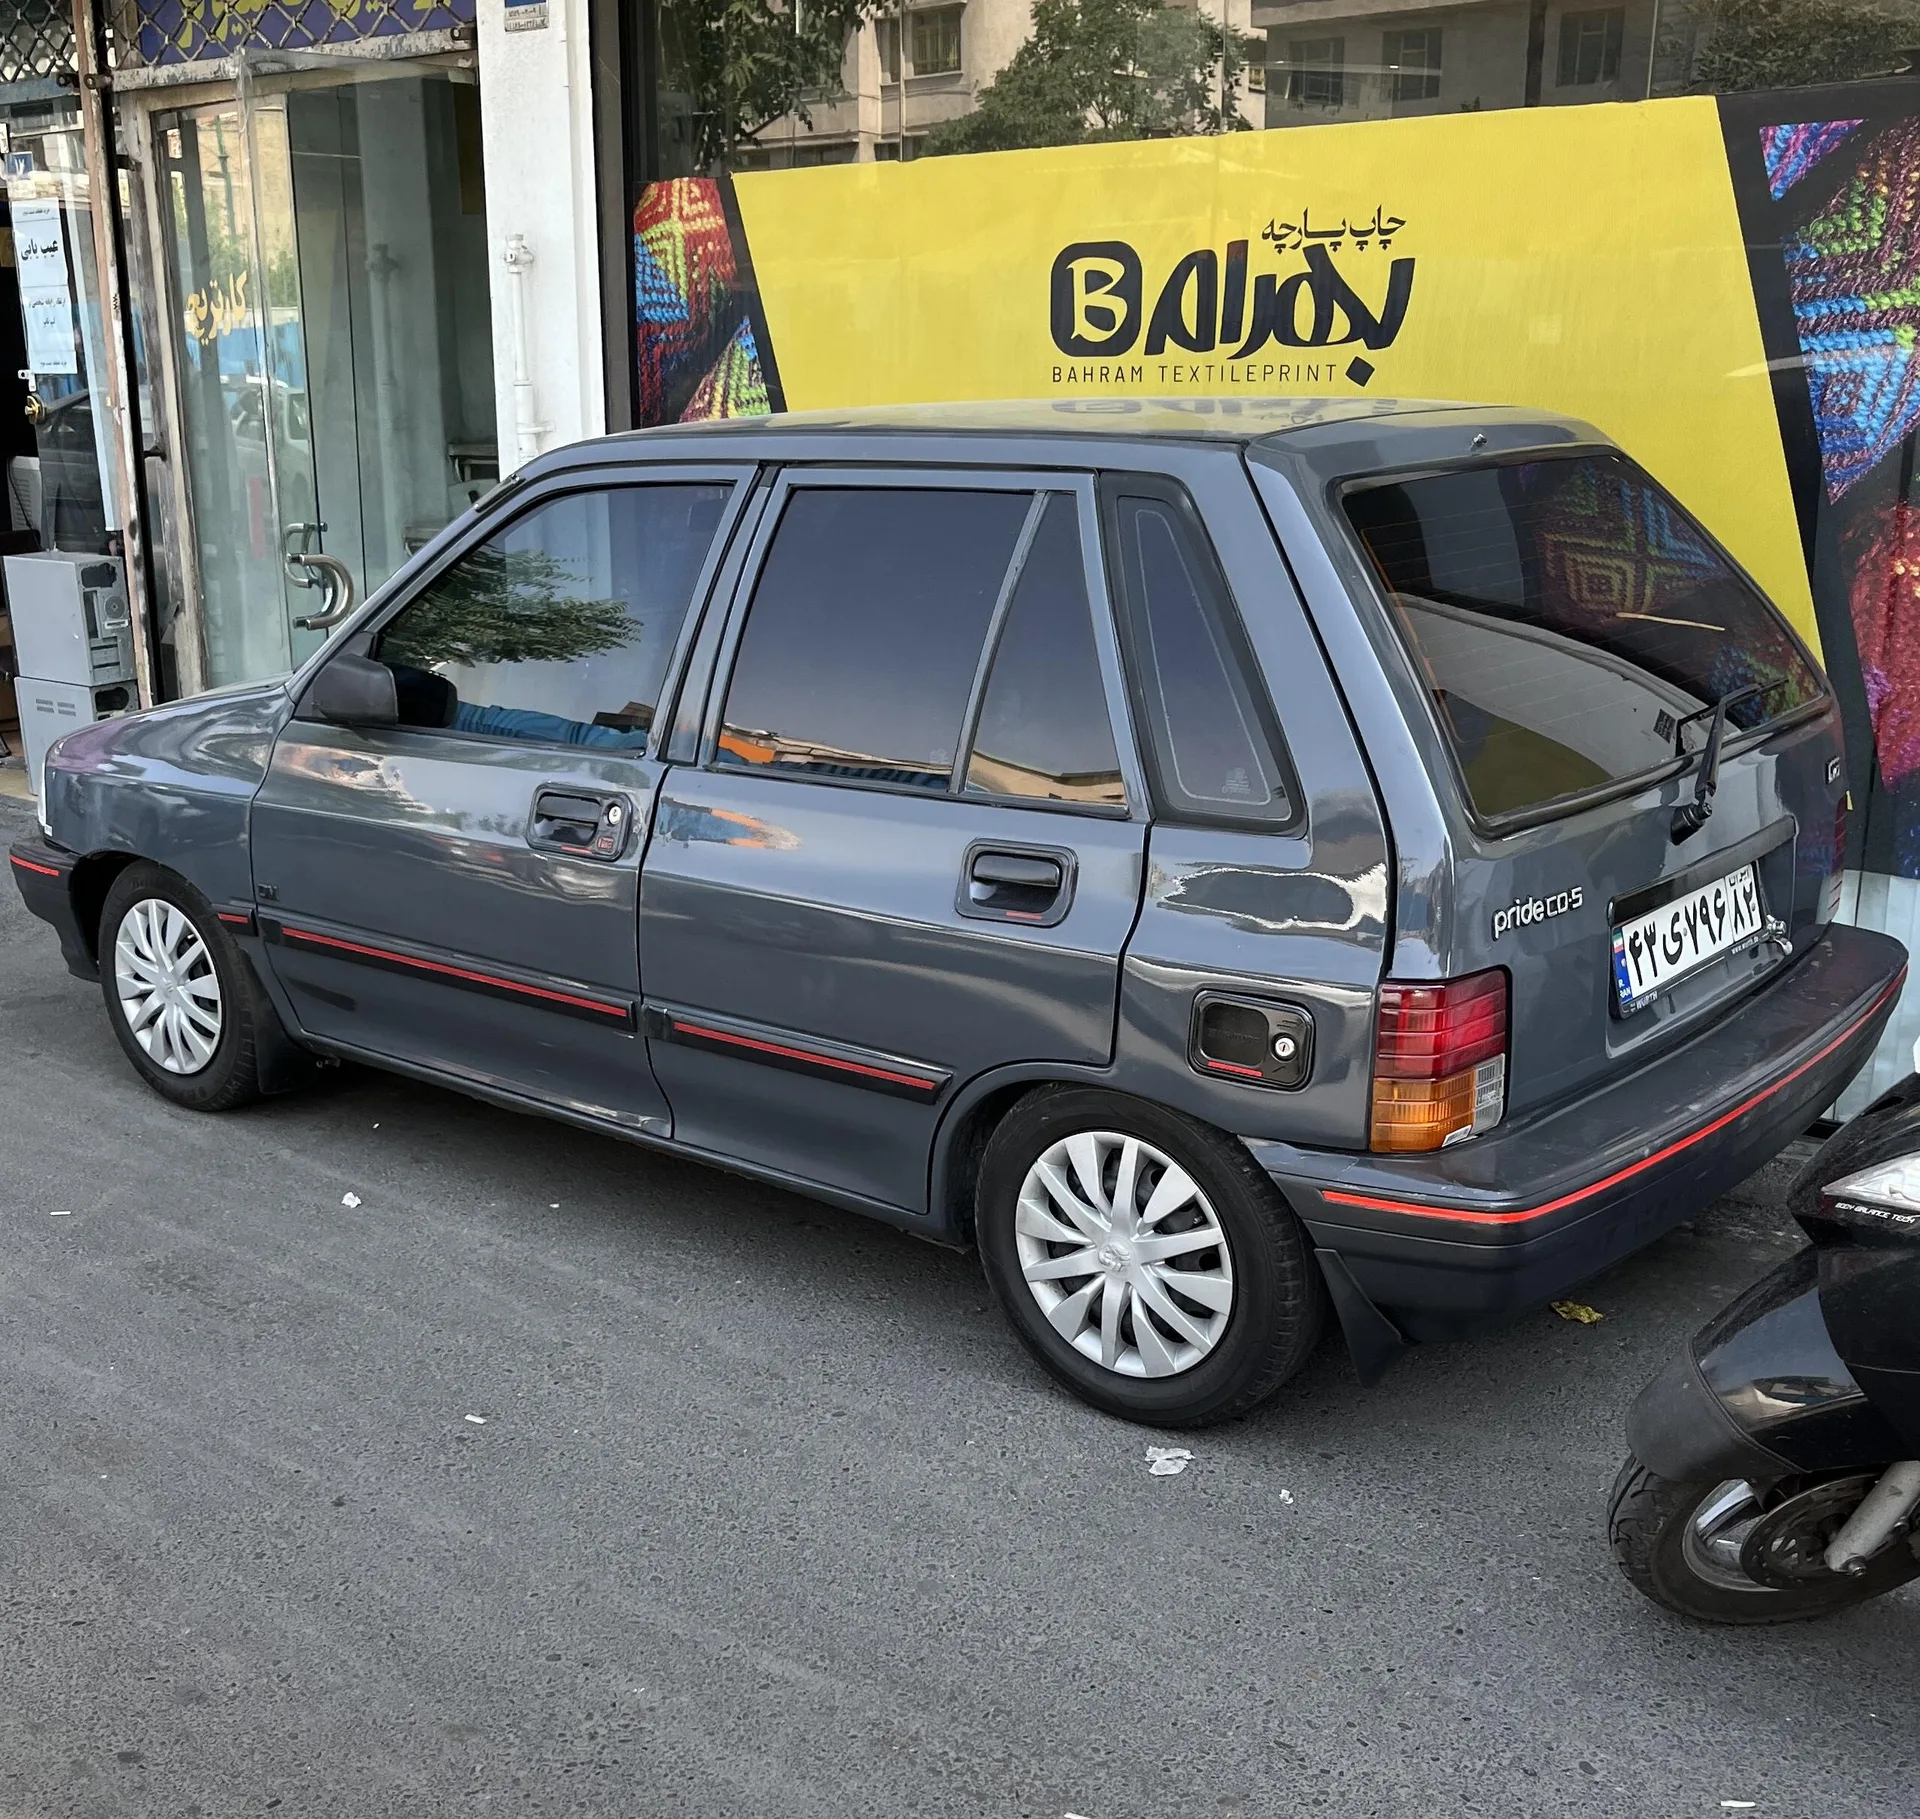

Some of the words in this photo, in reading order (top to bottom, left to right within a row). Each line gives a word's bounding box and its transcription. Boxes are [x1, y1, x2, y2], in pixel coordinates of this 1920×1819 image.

[1261, 207, 1346, 255] پارچه
[1350, 204, 1406, 251] چاپ
[1052, 366, 1143, 383] BAHRAM
[1159, 364, 1337, 383] TEXTILEPRINT
[1494, 897, 1545, 939] pride
[1835, 1202, 1855, 1210] BODY
[1854, 1206, 1891, 1218] BALANCE
[1892, 1214, 1915, 1223] TECH
